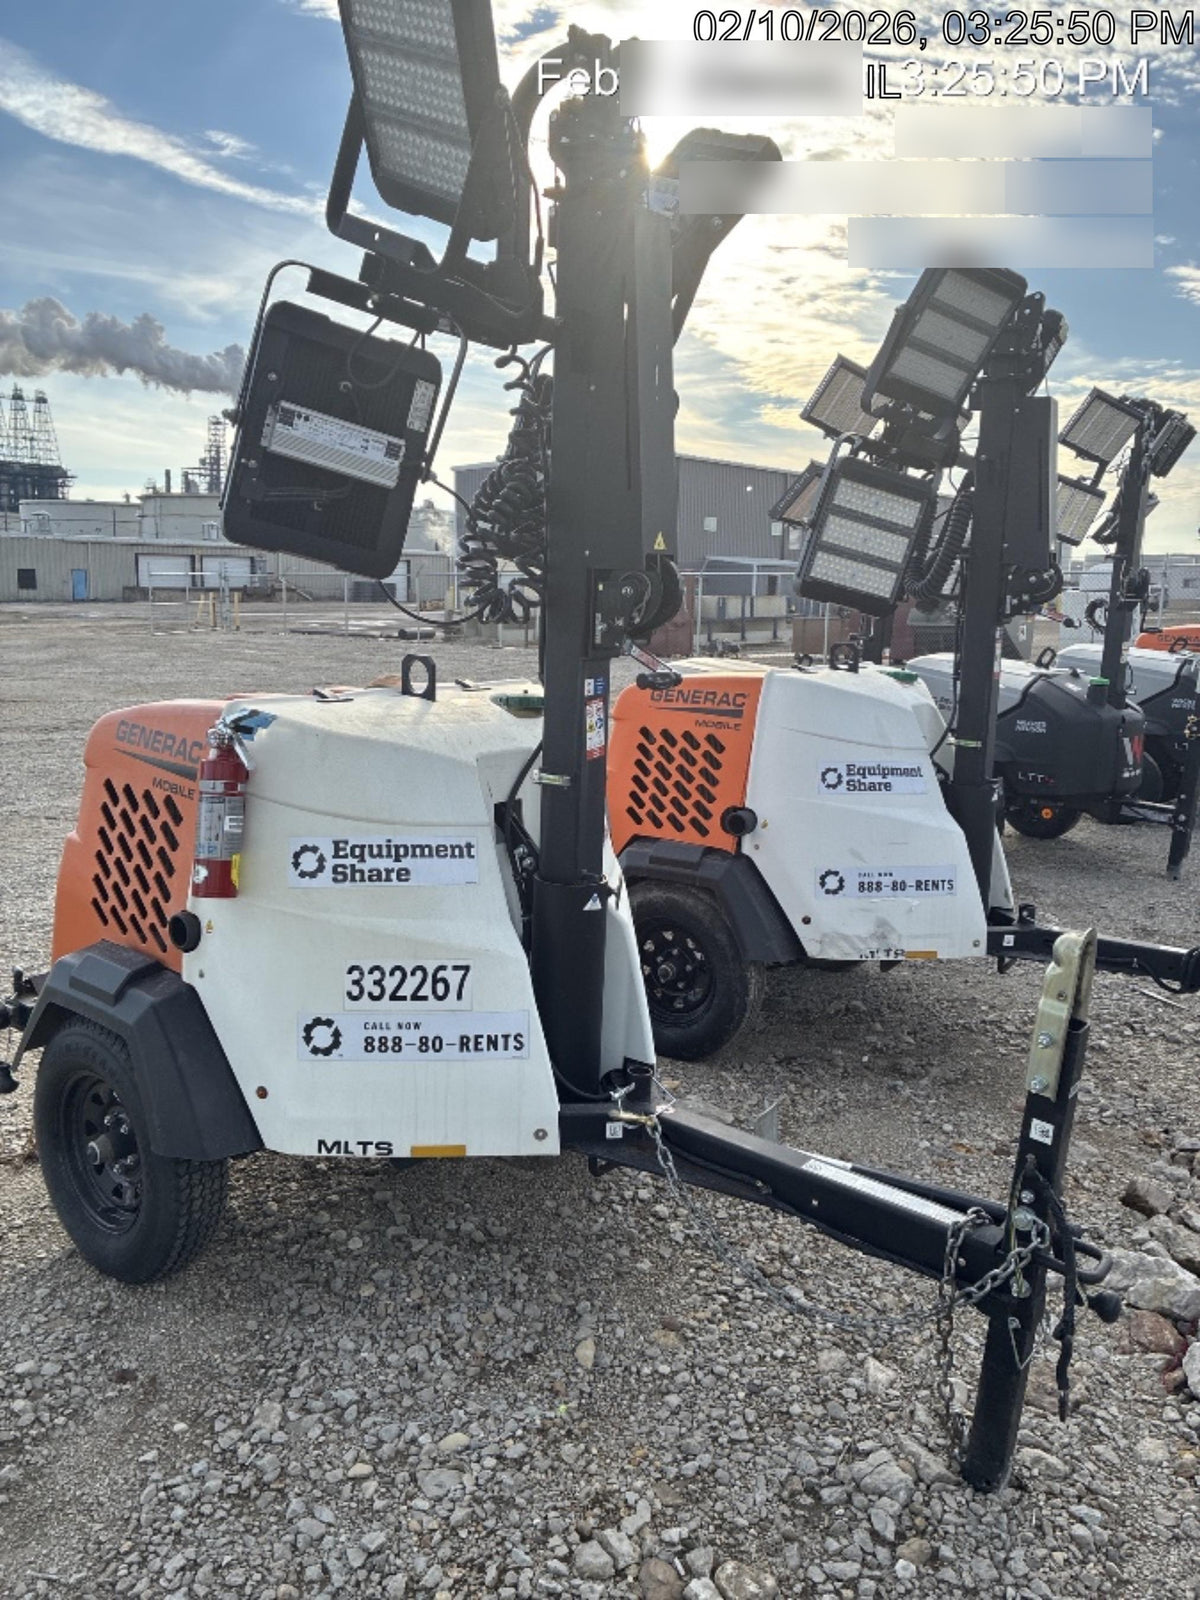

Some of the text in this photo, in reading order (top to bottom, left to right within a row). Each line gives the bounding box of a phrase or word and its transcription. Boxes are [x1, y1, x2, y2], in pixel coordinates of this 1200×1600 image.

[651, 689, 747, 708] GENERAC
[694, 719, 742, 731] MOBILE
[116, 720, 203, 764] GENERAC
[846, 764, 924, 779] Equipment
[152, 777, 196, 799] MOBILE
[846, 779, 892, 792] Share
[331, 839, 475, 862] Equipment
[331, 864, 411, 883] Share
[858, 880, 954, 893] 888-80-RENTS
[345, 964, 471, 1001] 332267
[363, 1021, 422, 1030] CALL NOW
[363, 1033, 525, 1053] 888-80-RENTS
[317, 1139, 394, 1156] MLTS
